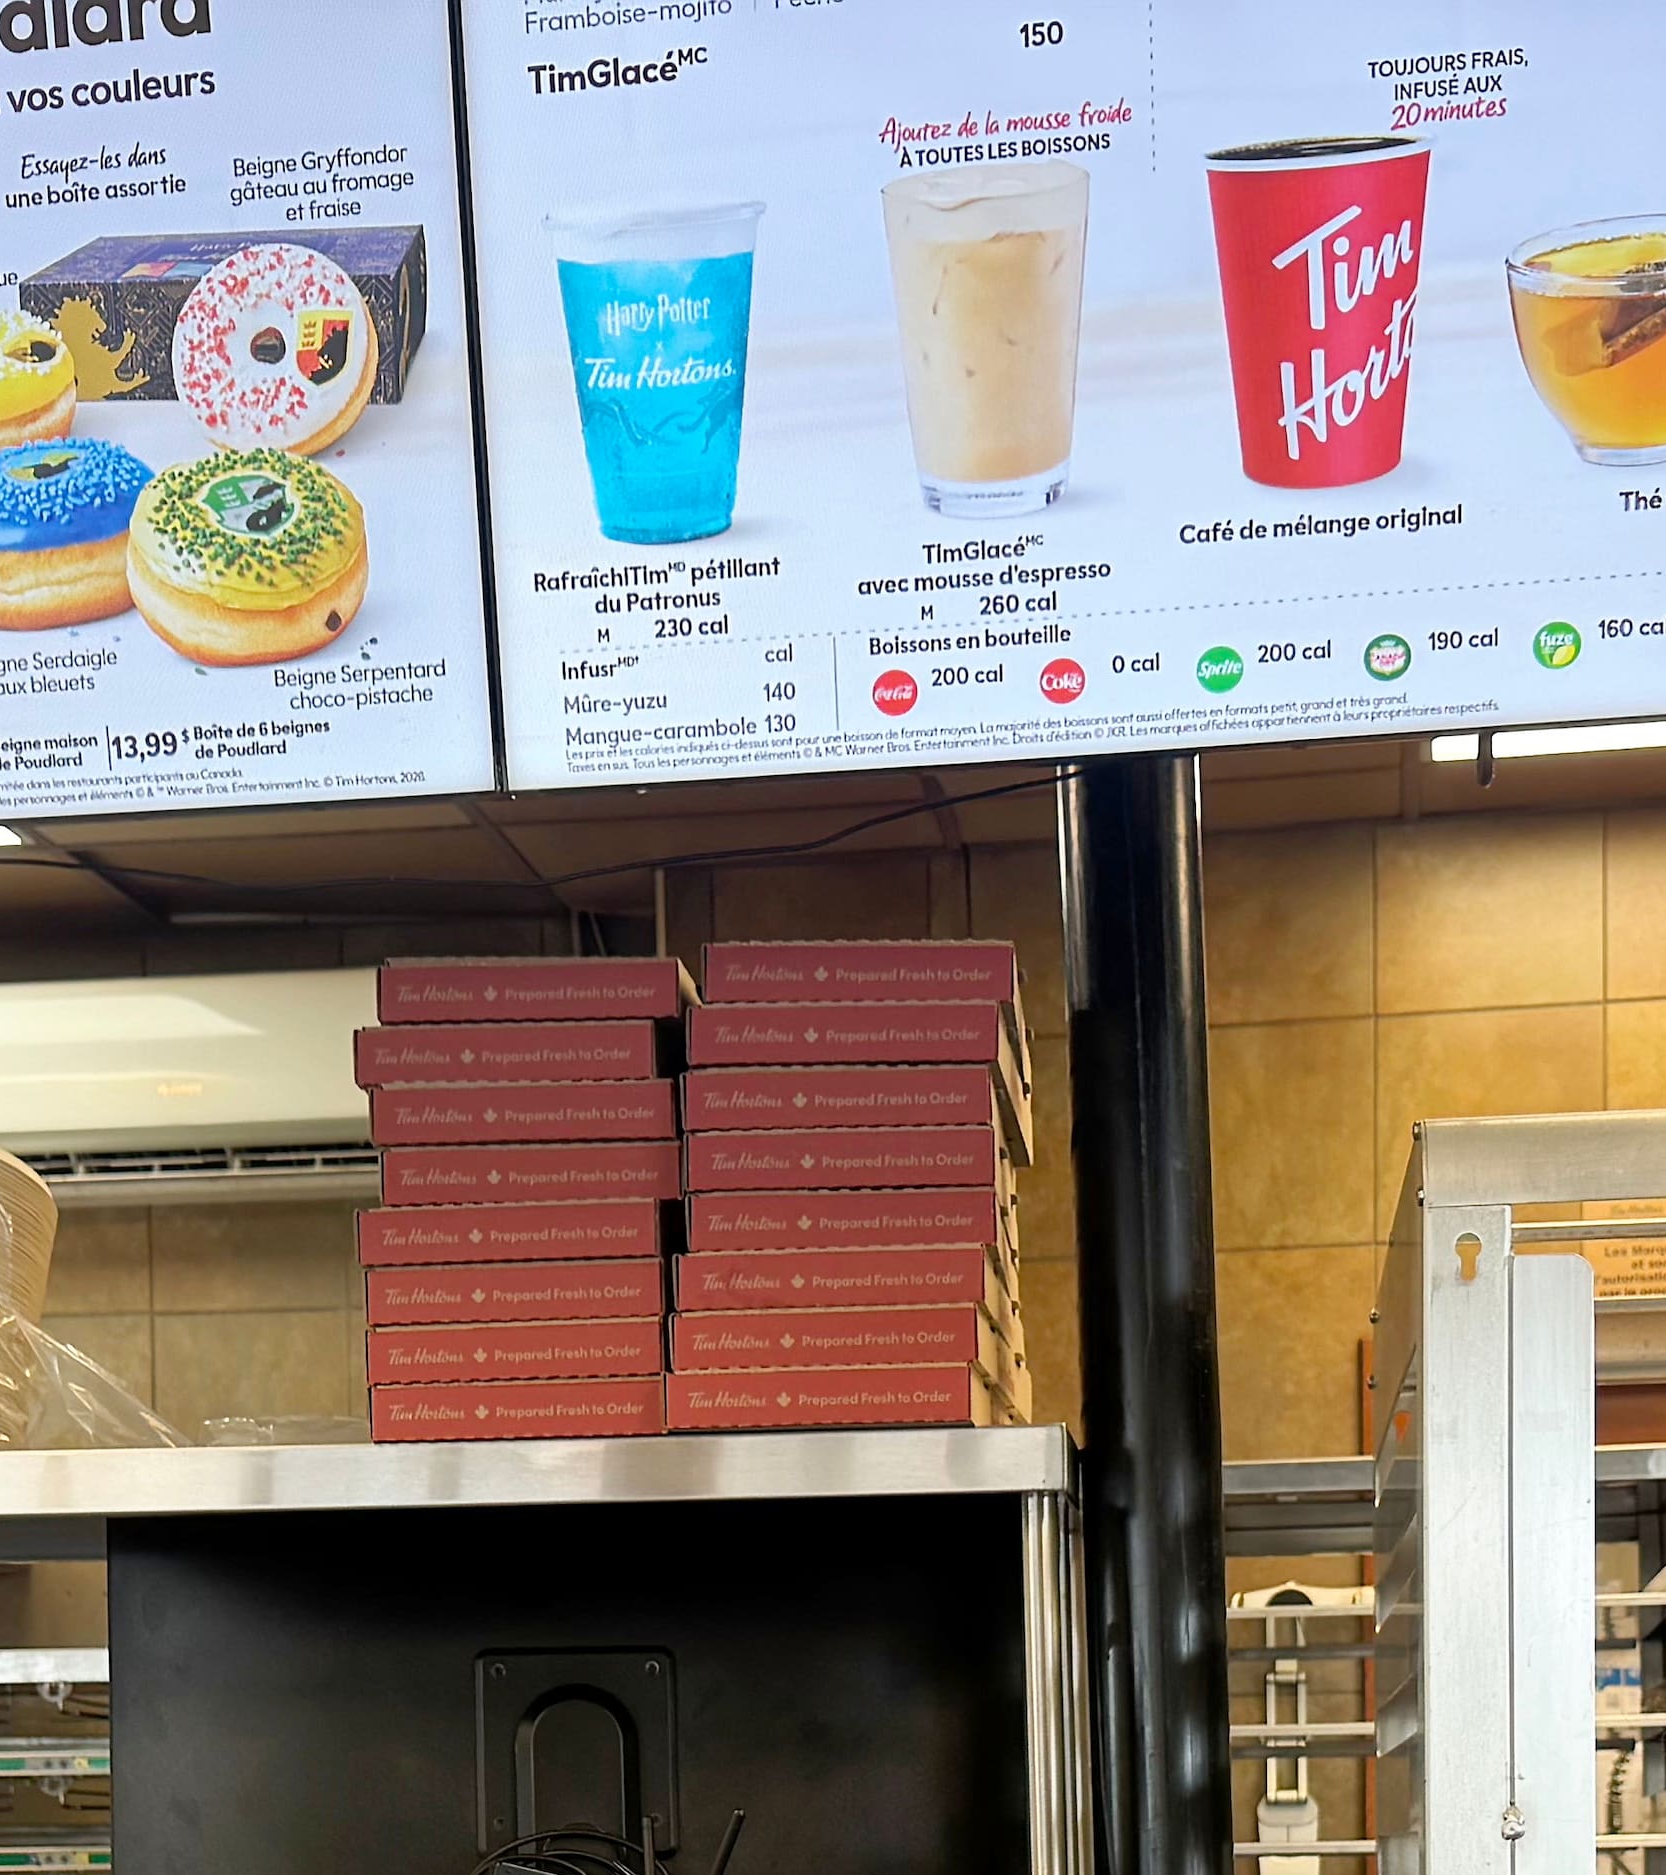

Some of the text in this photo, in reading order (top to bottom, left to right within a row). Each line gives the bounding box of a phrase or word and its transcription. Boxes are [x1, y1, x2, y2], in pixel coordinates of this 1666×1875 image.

[1019, 20, 1064, 48] 150
[1367, 47, 1529, 79] TOUJOURS FRAIS,
[6, 86, 64, 113] vos
[71, 68, 216, 107] couleurs
[1394, 72, 1503, 102] INFUSÉ AUX
[878, 96, 1132, 146] Ajoutez de la mousse froide
[21, 141, 166, 180] Essayez-les dans
[233, 143, 408, 180] Beigne Gryffondor
[899, 133, 1111, 169] À TOUTES LES BOISSONS
[5, 173, 187, 209] une boîte assortie
[230, 172, 414, 208] gâteau au fromage
[285, 198, 361, 222] et fraise
[1271, 204, 1414, 331] Tim
[605, 293, 711, 337] Harry Potter
[584, 357, 632, 390] Tim
[1618, 487, 1663, 512] Thé
[1179, 503, 1462, 545] Café de mélange original
[857, 563, 1112, 595] avec mousse d'espresso
[594, 591, 721, 614] du Patronus
[654, 613, 729, 639] 230 cal
[869, 623, 1071, 656] Boissons en bouteille
[1598, 618, 1634, 640] 160
[1257, 639, 1331, 664] 200 cal
[273, 657, 446, 691] Beigne Serpentard
[1041, 672, 1083, 693] Coke
[289, 683, 433, 711] choco-pistache
[564, 682, 796, 717] Mûre-yuzu 140
[111, 731, 178, 764] 13,99
[836, 968, 896, 982] Prepared
[899, 969, 935, 982] Fresh
[937, 970, 949, 981] to
[953, 968, 992, 982] Order
[687, 1392, 713, 1408] Tim
[798, 1392, 859, 1408] Prepared
[861, 1394, 895, 1405] Fresh
[897, 1392, 910, 1404] to
[913, 1390, 952, 1404] Order
